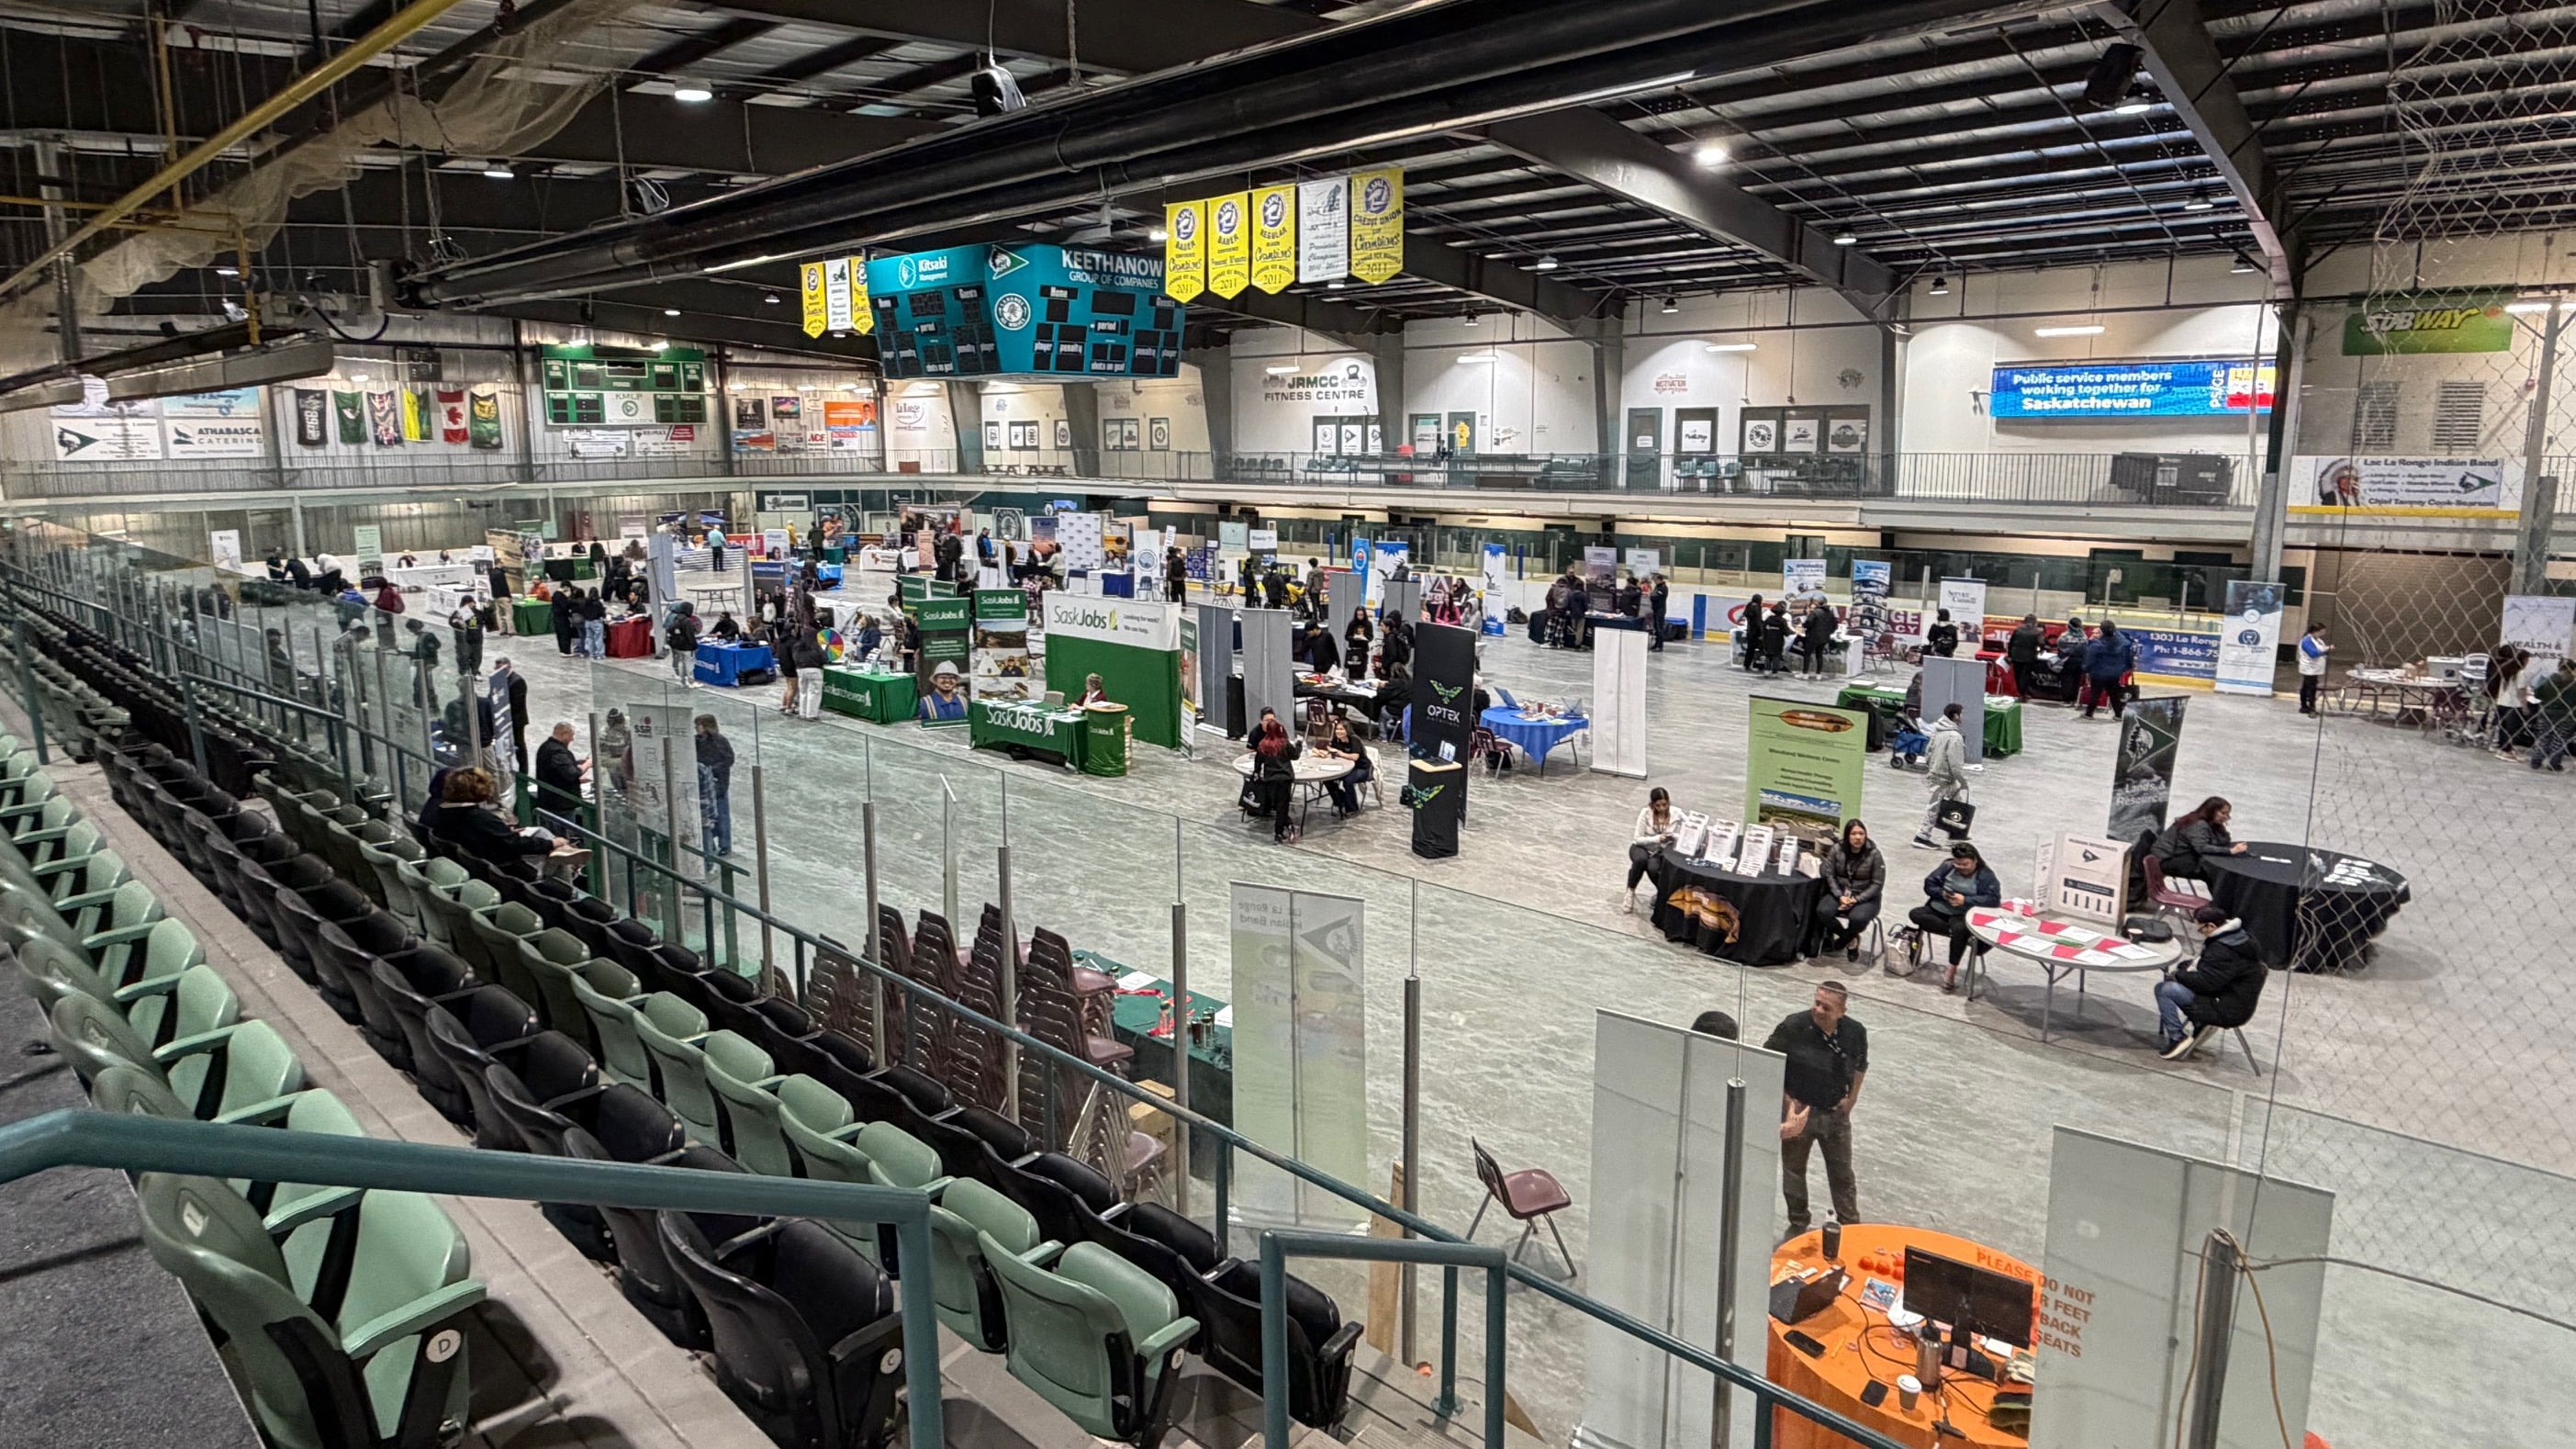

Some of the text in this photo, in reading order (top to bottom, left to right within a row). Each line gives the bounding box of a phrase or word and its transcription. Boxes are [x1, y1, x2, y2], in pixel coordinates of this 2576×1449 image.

[1380, 208, 1401, 224] UNION
[1260, 227, 1287, 239] REGULAR
[918, 256, 947, 273] Kitsaki
[1061, 250, 1162, 277] KEETHANOW
[1367, 264, 1387, 275] 2011
[1069, 271, 1159, 288] GROUP OF COMPANIES
[1221, 279, 1237, 290] 2011
[1263, 274, 1282, 285] 2011
[1177, 284, 1193, 294] 2011
[1097, 321, 1116, 331] period
[2360, 309, 2481, 331] SUBWAY
[1288, 376, 1338, 389] JRMCC
[2013, 371, 2172, 386] Public service members
[1265, 389, 1365, 402] FITNESS CENTRE
[2021, 383, 2161, 396] working together for
[2022, 397, 2152, 410] Saskatchewan
[198, 427, 261, 435] ATHABASCA
[809, 433, 826, 442] ACE
[2399, 459, 2431, 468] Ronge
[980, 595, 1014, 604] SaskJobs
[924, 610, 957, 621] SaskJobs
[1054, 605, 1107, 630] SaskJobs
[2150, 634, 2222, 646] 1303 La Rong
[2154, 646, 2170, 654] Ph:
[2173, 646, 2220, 657] 1-866-75
[986, 705, 1043, 734] SaskJobs
[1427, 705, 1460, 723] OPTEK
[1977, 1250, 2033, 1282] PLEASE
[2038, 1275, 2058, 1292] DO
[2064, 1284, 2095, 1306] NOT
[2055, 1299, 2091, 1323] FEET
[2040, 1312, 2082, 1339] BACK
[439, 1338, 452, 1354] D
[2034, 1330, 2082, 1358] SEATS
[887, 1354, 897, 1368] C
